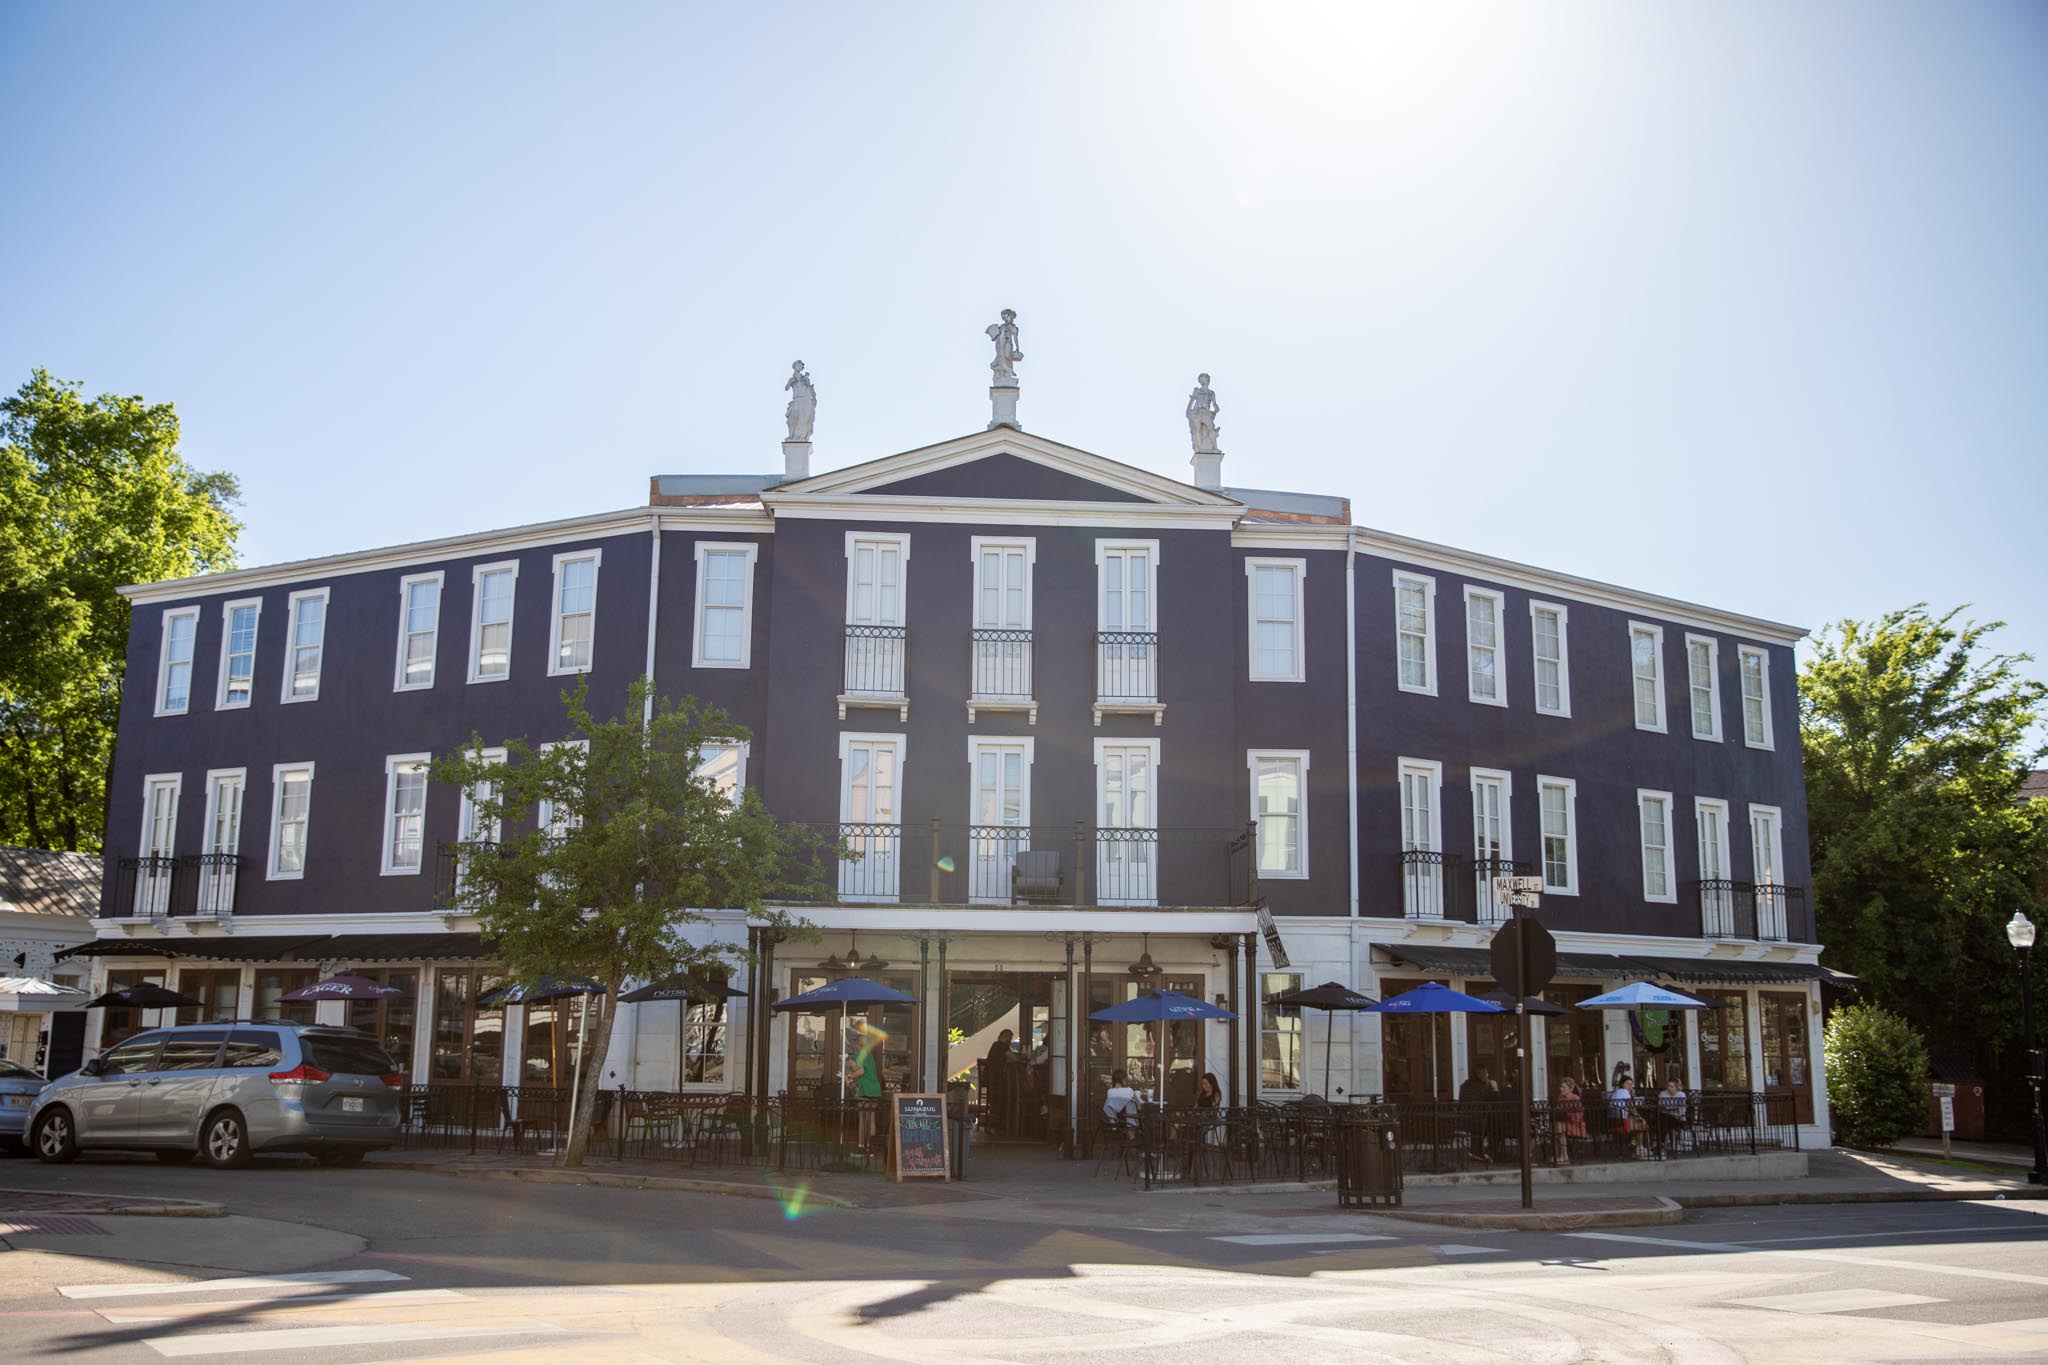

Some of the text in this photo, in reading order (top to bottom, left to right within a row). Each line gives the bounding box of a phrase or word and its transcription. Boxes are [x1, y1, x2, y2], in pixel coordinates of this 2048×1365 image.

[1496, 878, 1531, 891] MAXWELL
[1500, 892, 1530, 906] UNIVERSITY
[300, 983, 353, 996] LAGER
